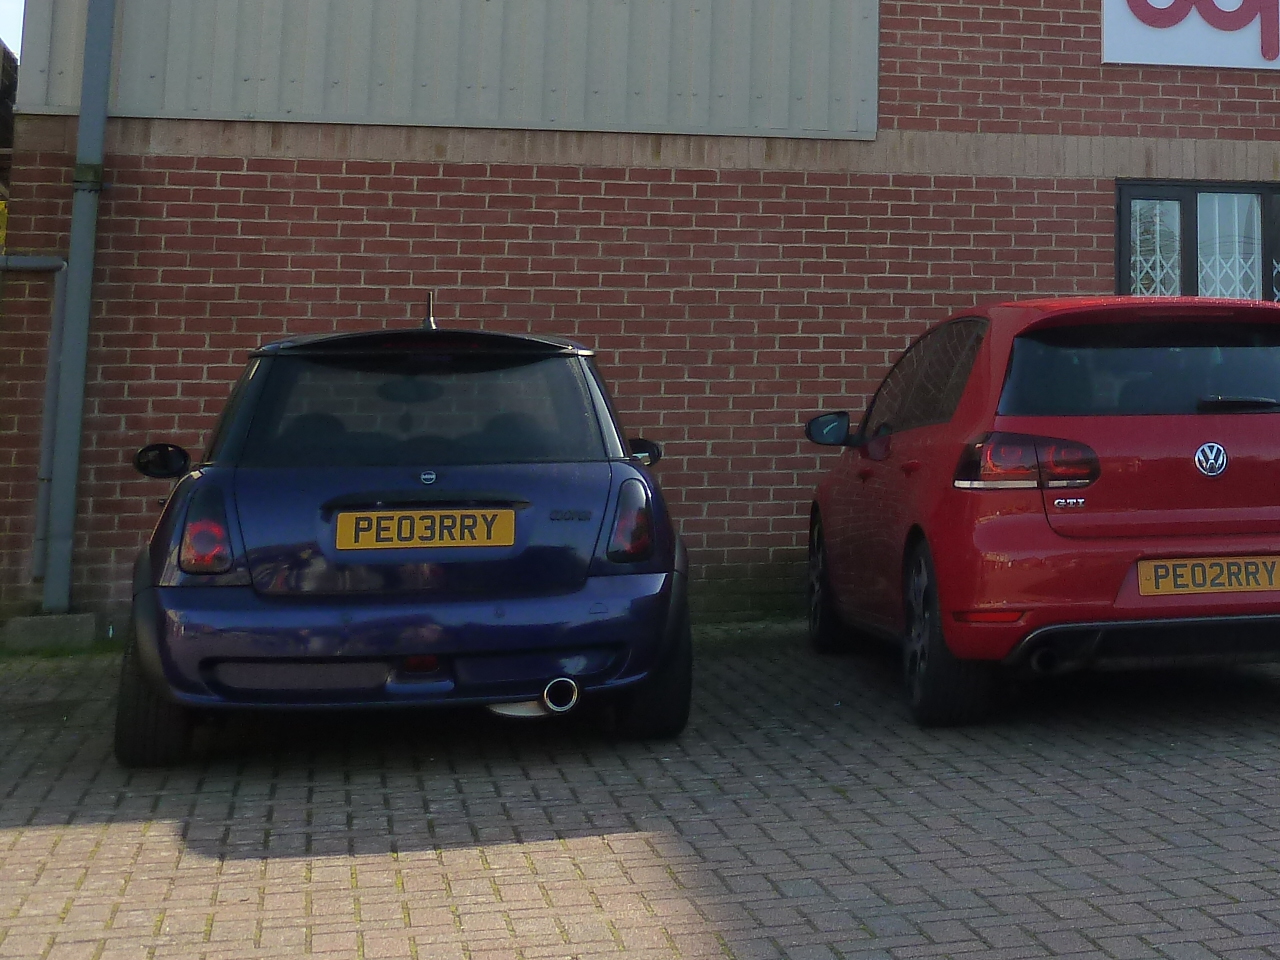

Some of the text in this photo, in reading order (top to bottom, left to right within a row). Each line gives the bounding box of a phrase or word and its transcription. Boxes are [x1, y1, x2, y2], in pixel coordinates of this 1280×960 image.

[1054, 498, 1085, 508] GTI
[353, 513, 499, 544] PE03RRY
[1153, 560, 1277, 590] PE02RRY
